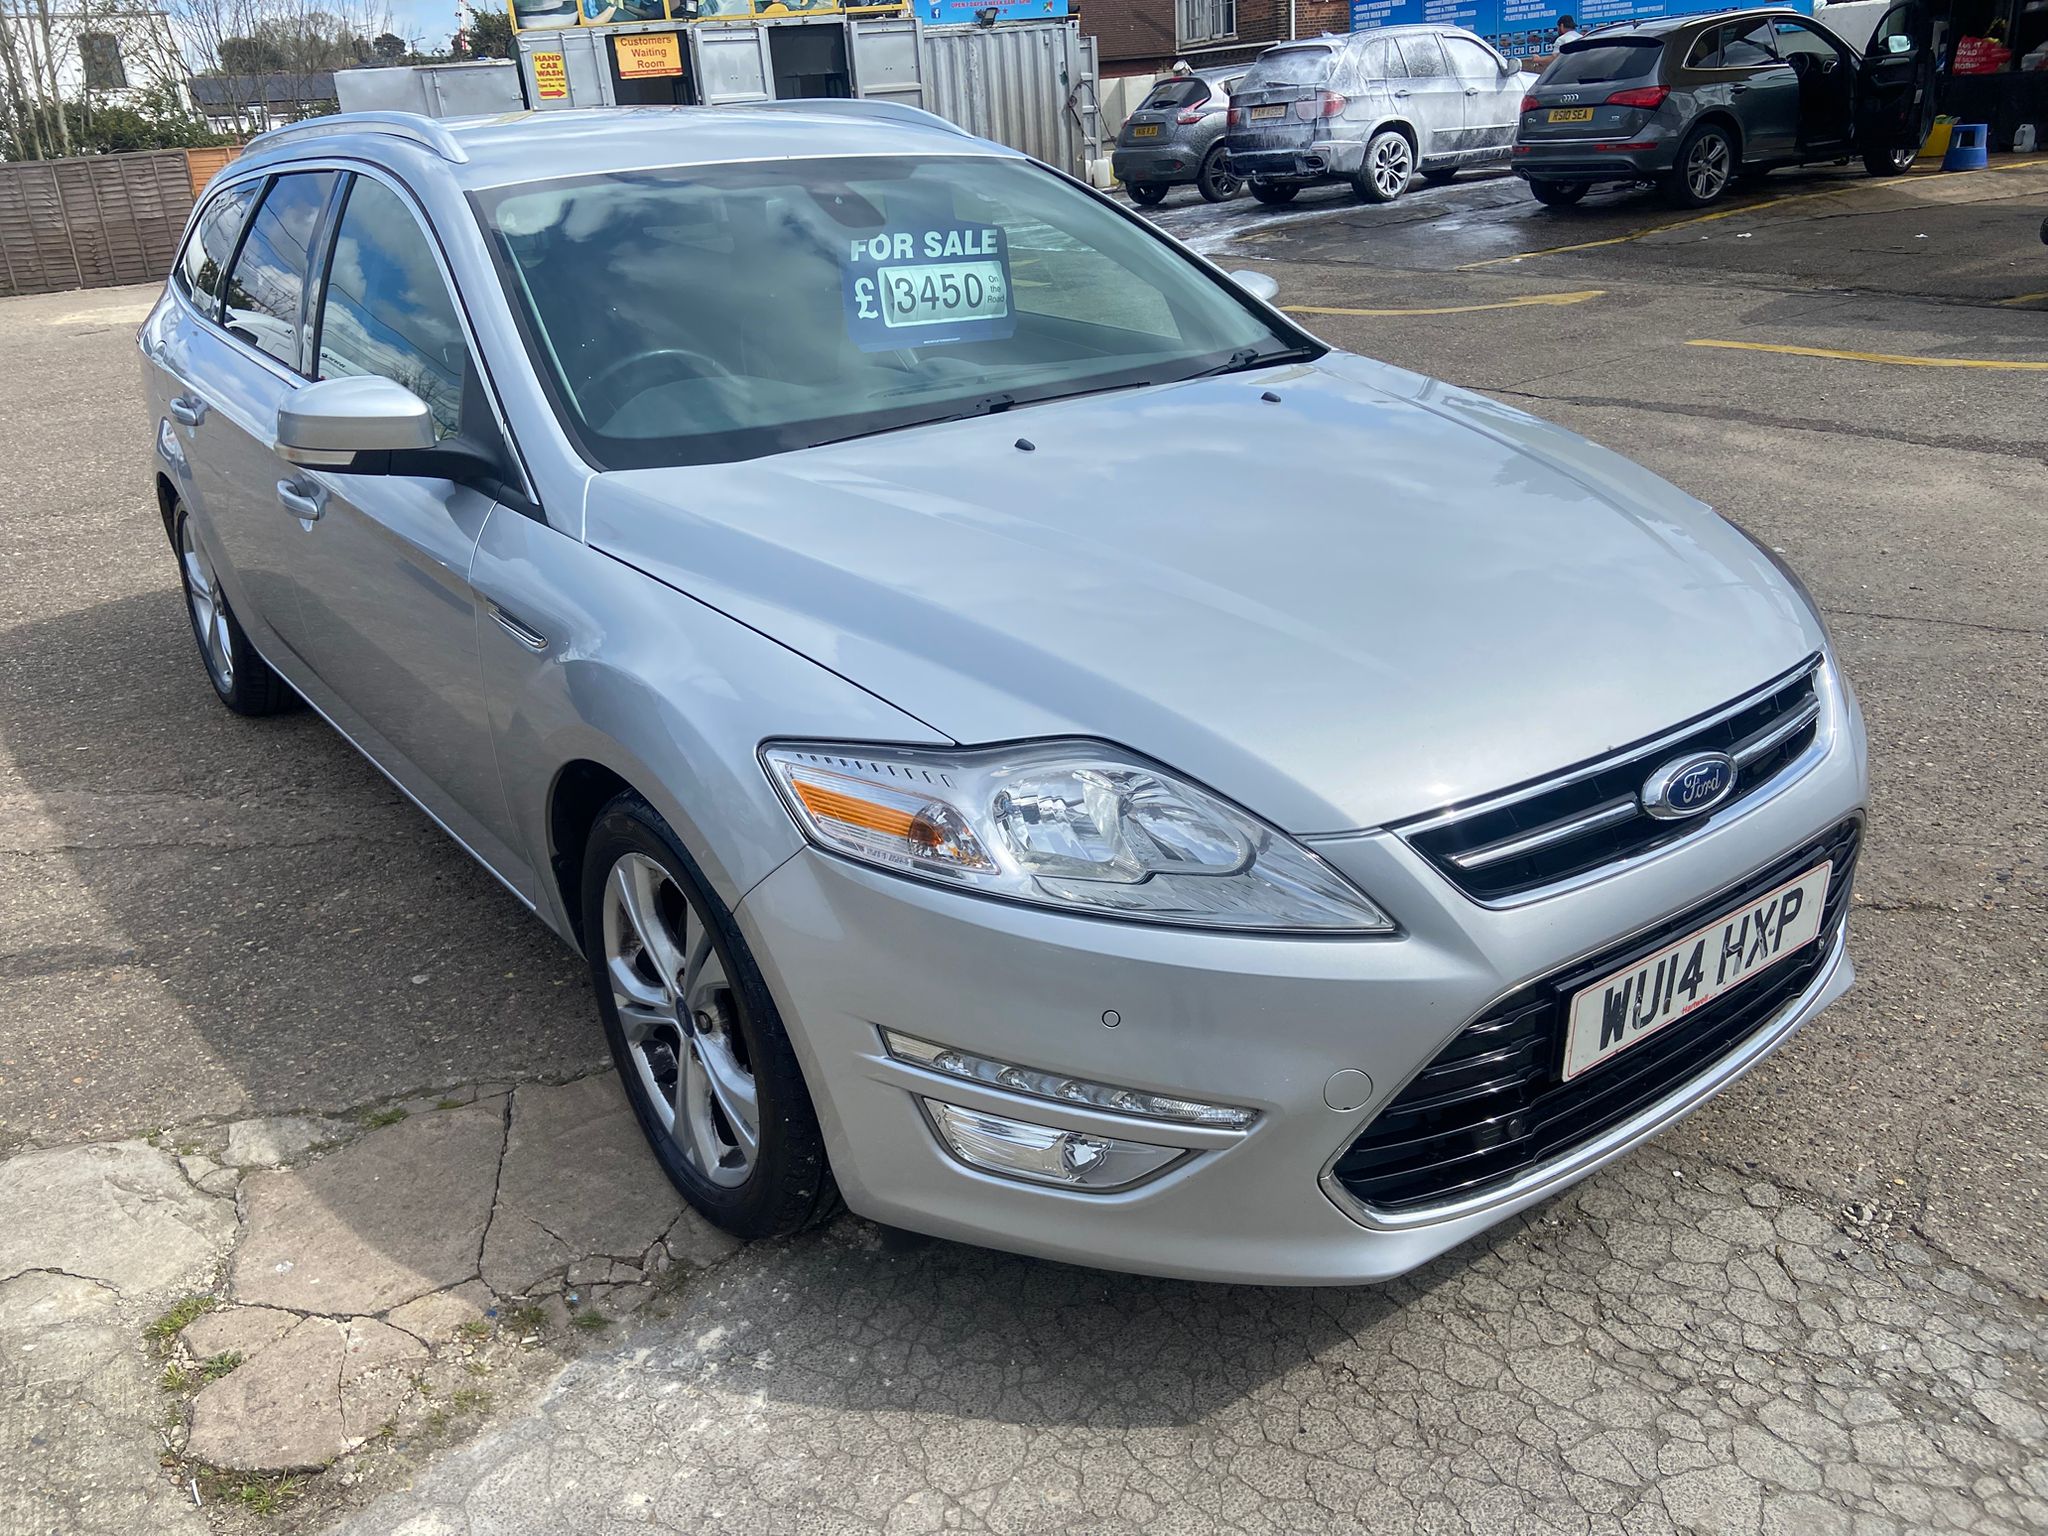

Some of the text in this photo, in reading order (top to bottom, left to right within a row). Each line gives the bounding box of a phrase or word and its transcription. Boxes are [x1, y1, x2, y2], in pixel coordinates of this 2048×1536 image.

[620, 36, 672, 46] Customers
[534, 54, 562, 62] HAND
[631, 48, 667, 58] Waiting
[637, 60, 665, 69] Room
[1571, 109, 1588, 120] SEA
[851, 229, 998, 262] FOR SALE
[988, 275, 999, 283] On
[990, 285, 1001, 294] the
[854, 273, 984, 320] £ 3450
[987, 295, 1005, 304] Road
[1682, 767, 1721, 804] Ford
[1599, 887, 1804, 1051] WU14 HXP
